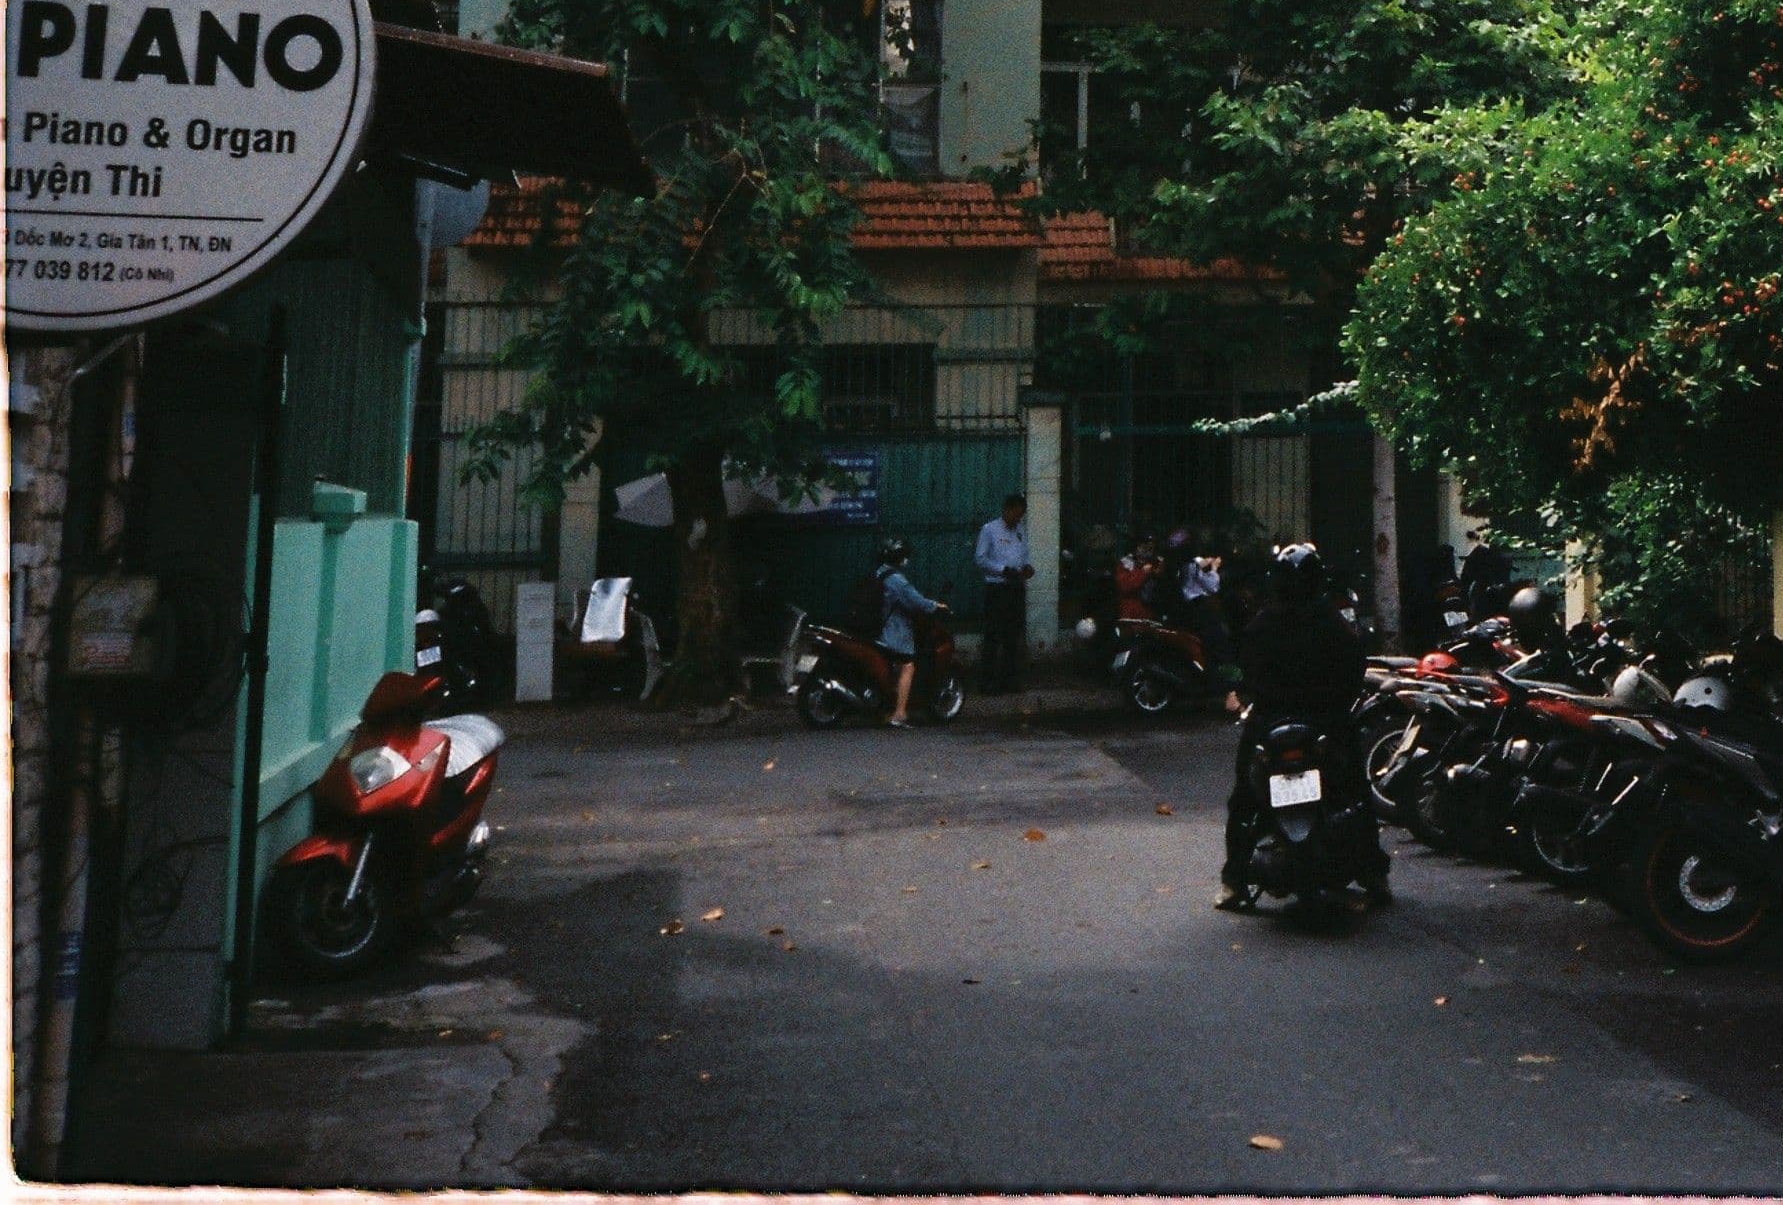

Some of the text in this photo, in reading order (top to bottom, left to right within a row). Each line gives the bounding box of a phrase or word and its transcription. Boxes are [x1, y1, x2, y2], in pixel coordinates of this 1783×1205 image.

[16, 0, 345, 92] PIANO
[23, 111, 297, 160] Piano & Organ
[106, 163, 163, 198] Thi
[15, 227, 45, 247] Dốc
[78, 233, 92, 250] 2,
[97, 233, 123, 249] Gia
[128, 234, 156, 250] Tân
[161, 235, 174, 252] 1,
[179, 236, 204, 253] TN,
[208, 237, 233, 252] ĐN
[34, 260, 71, 280] 039
[77, 261, 115, 282] 812
